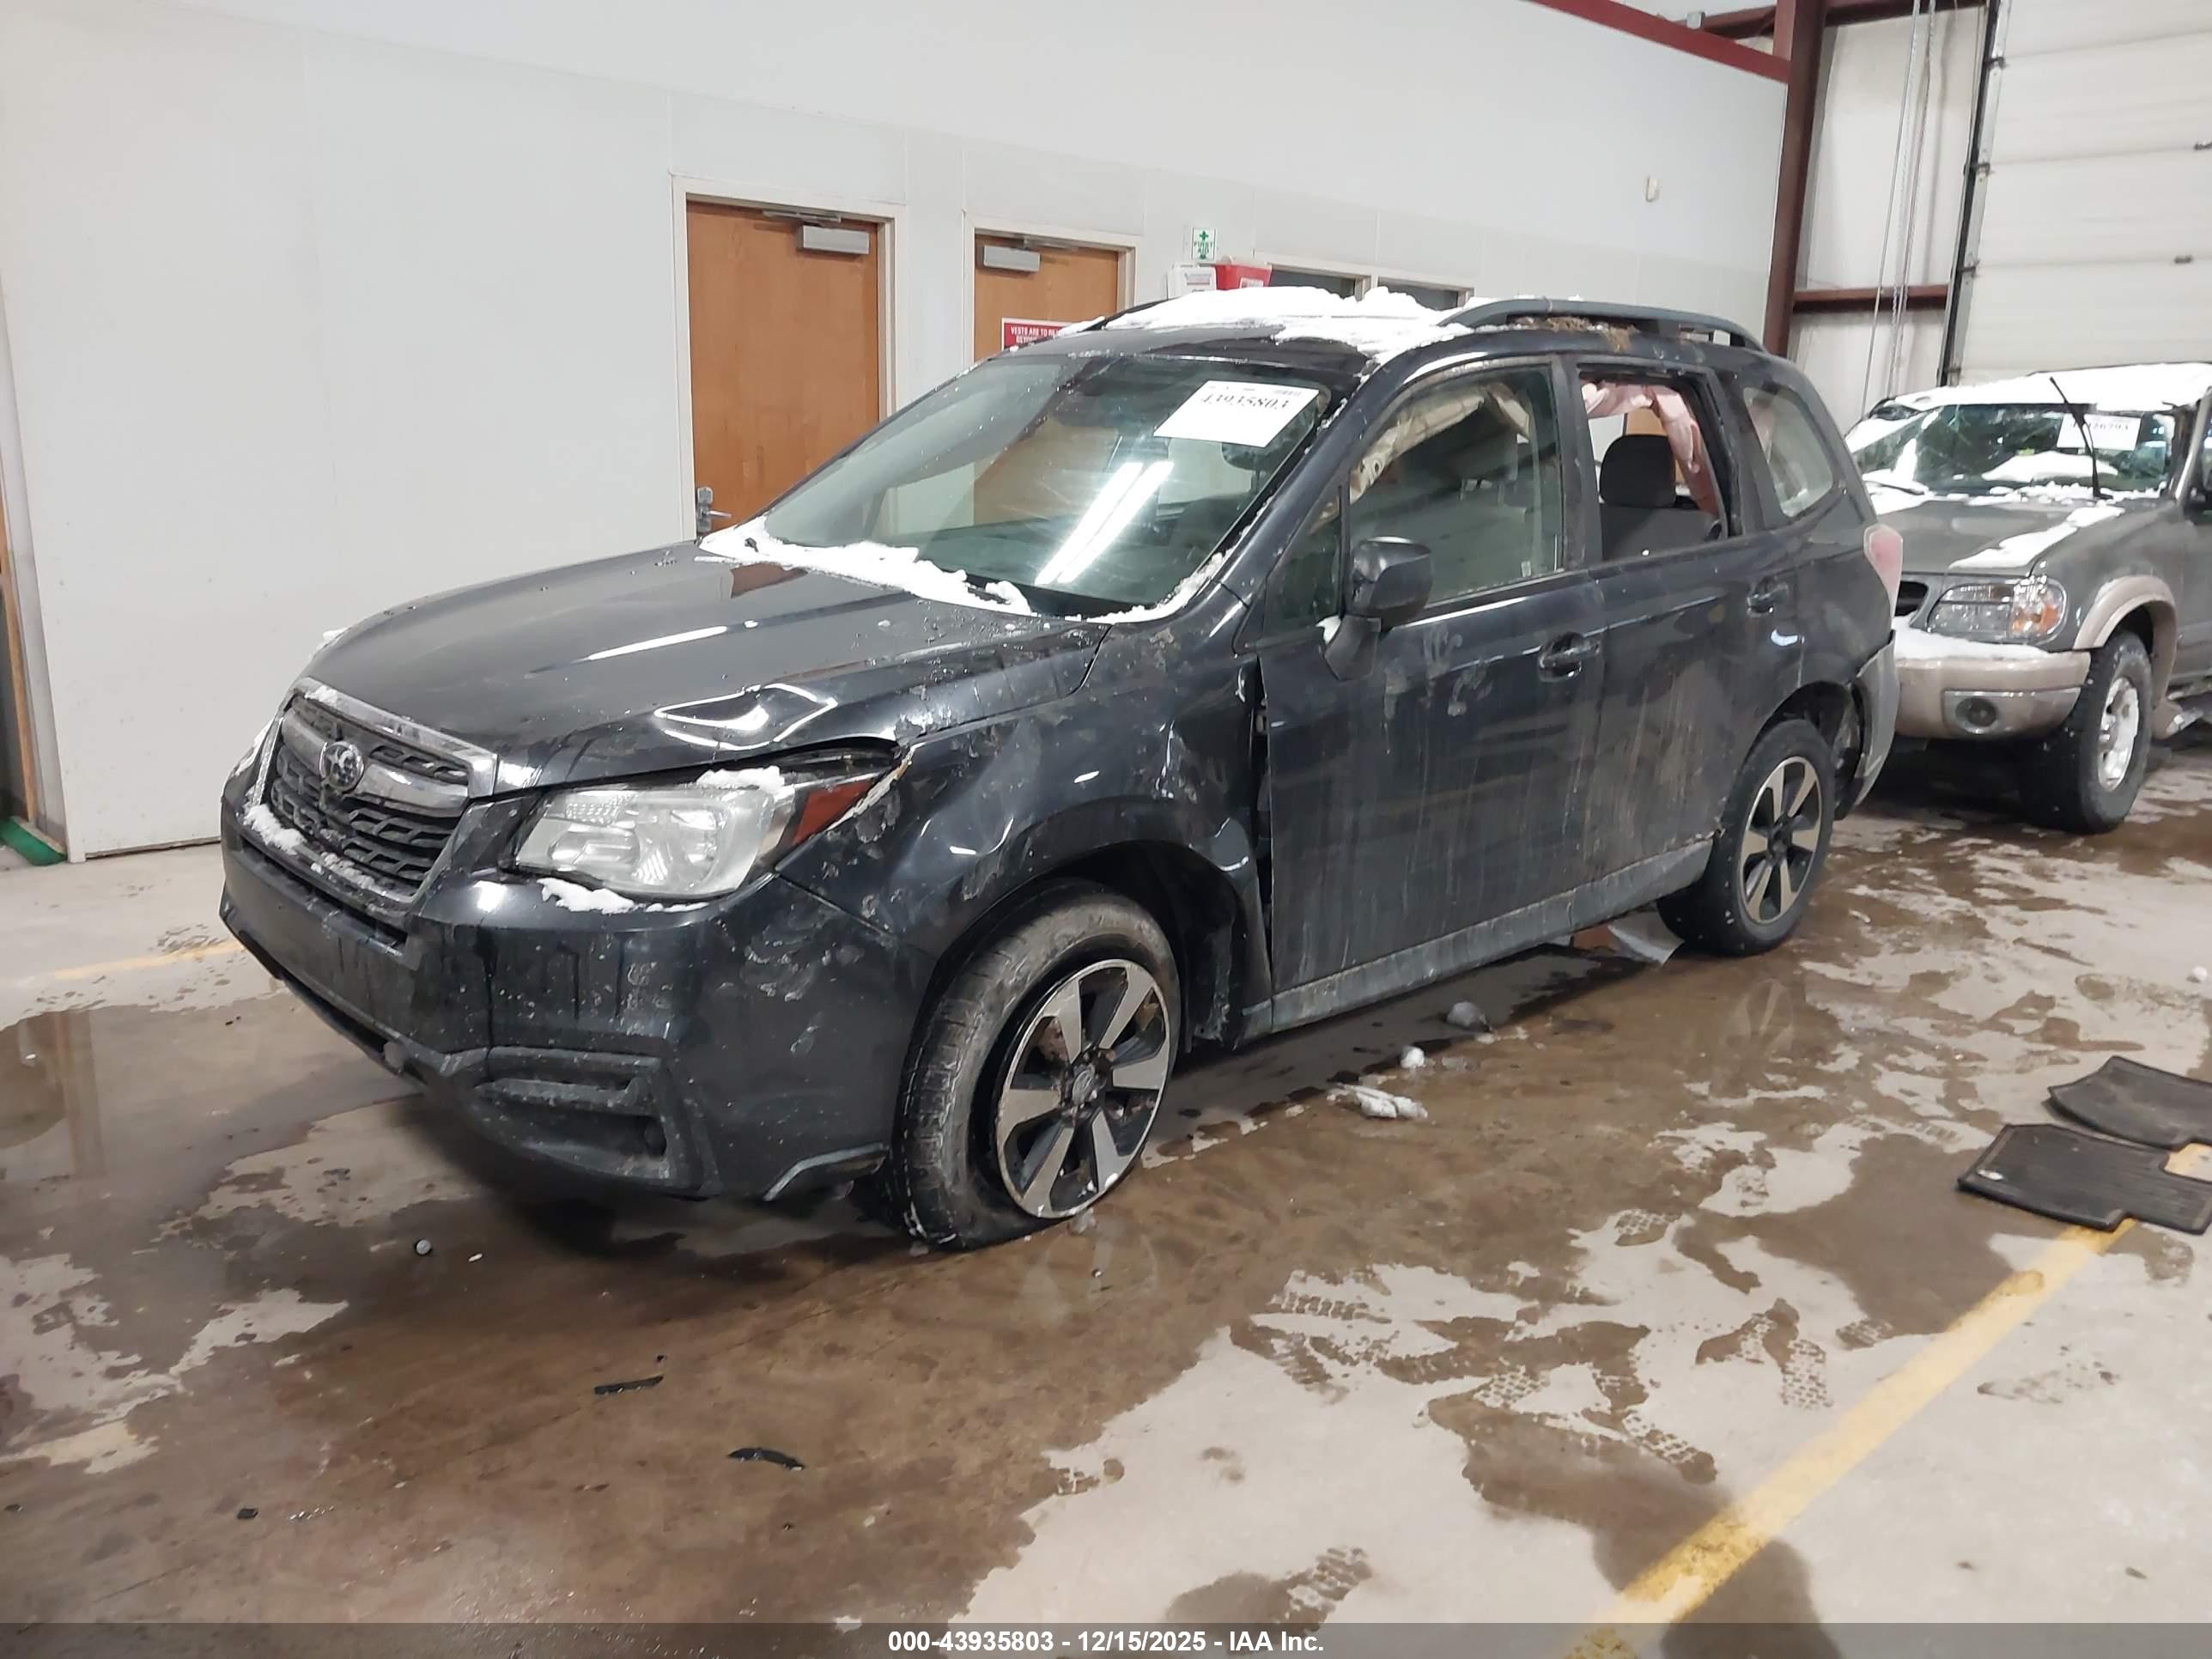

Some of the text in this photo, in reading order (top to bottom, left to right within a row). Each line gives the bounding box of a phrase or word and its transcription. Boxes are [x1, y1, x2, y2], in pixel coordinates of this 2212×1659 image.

[1011, 326, 1028, 336] VESTS
[1029, 327, 1040, 337] ARE
[1041, 327, 1048, 337] TO
